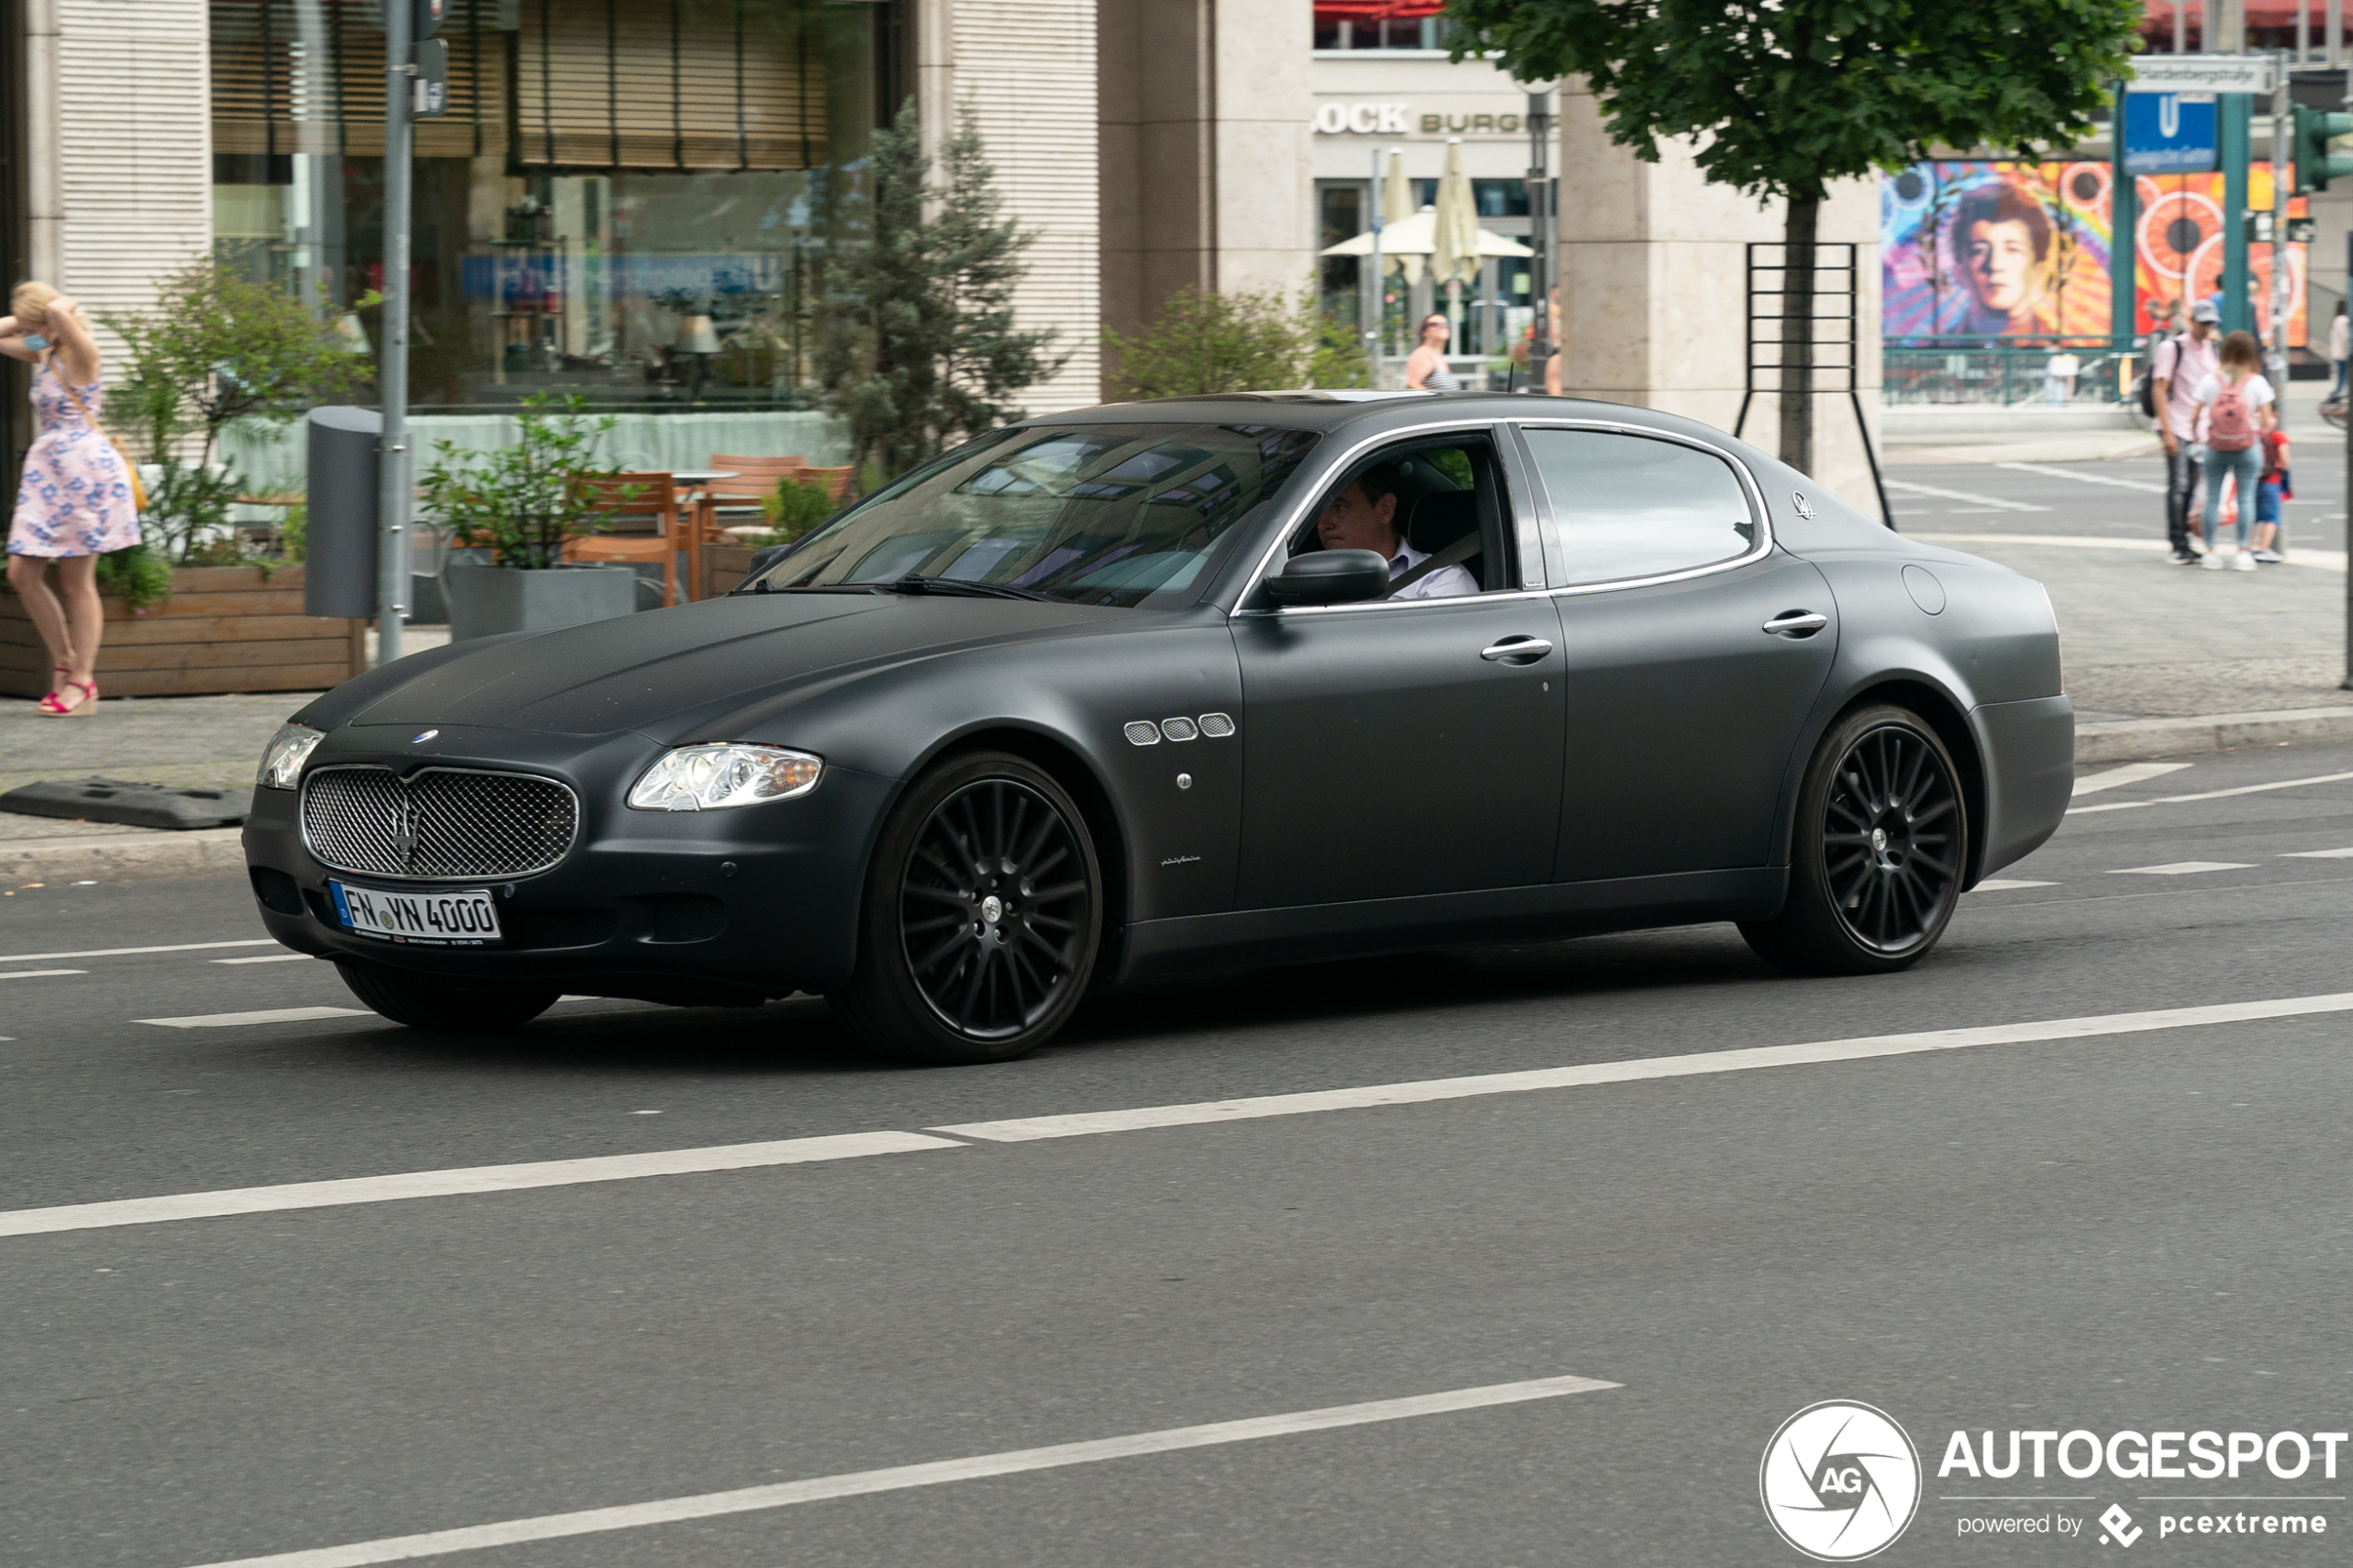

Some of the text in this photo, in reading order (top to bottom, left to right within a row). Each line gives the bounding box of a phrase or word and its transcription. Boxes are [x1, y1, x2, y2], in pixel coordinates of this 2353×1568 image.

[1310, 101, 1409, 134] OCK
[2159, 94, 2179, 138] U
[345, 890, 494, 933] FN YN 4000
